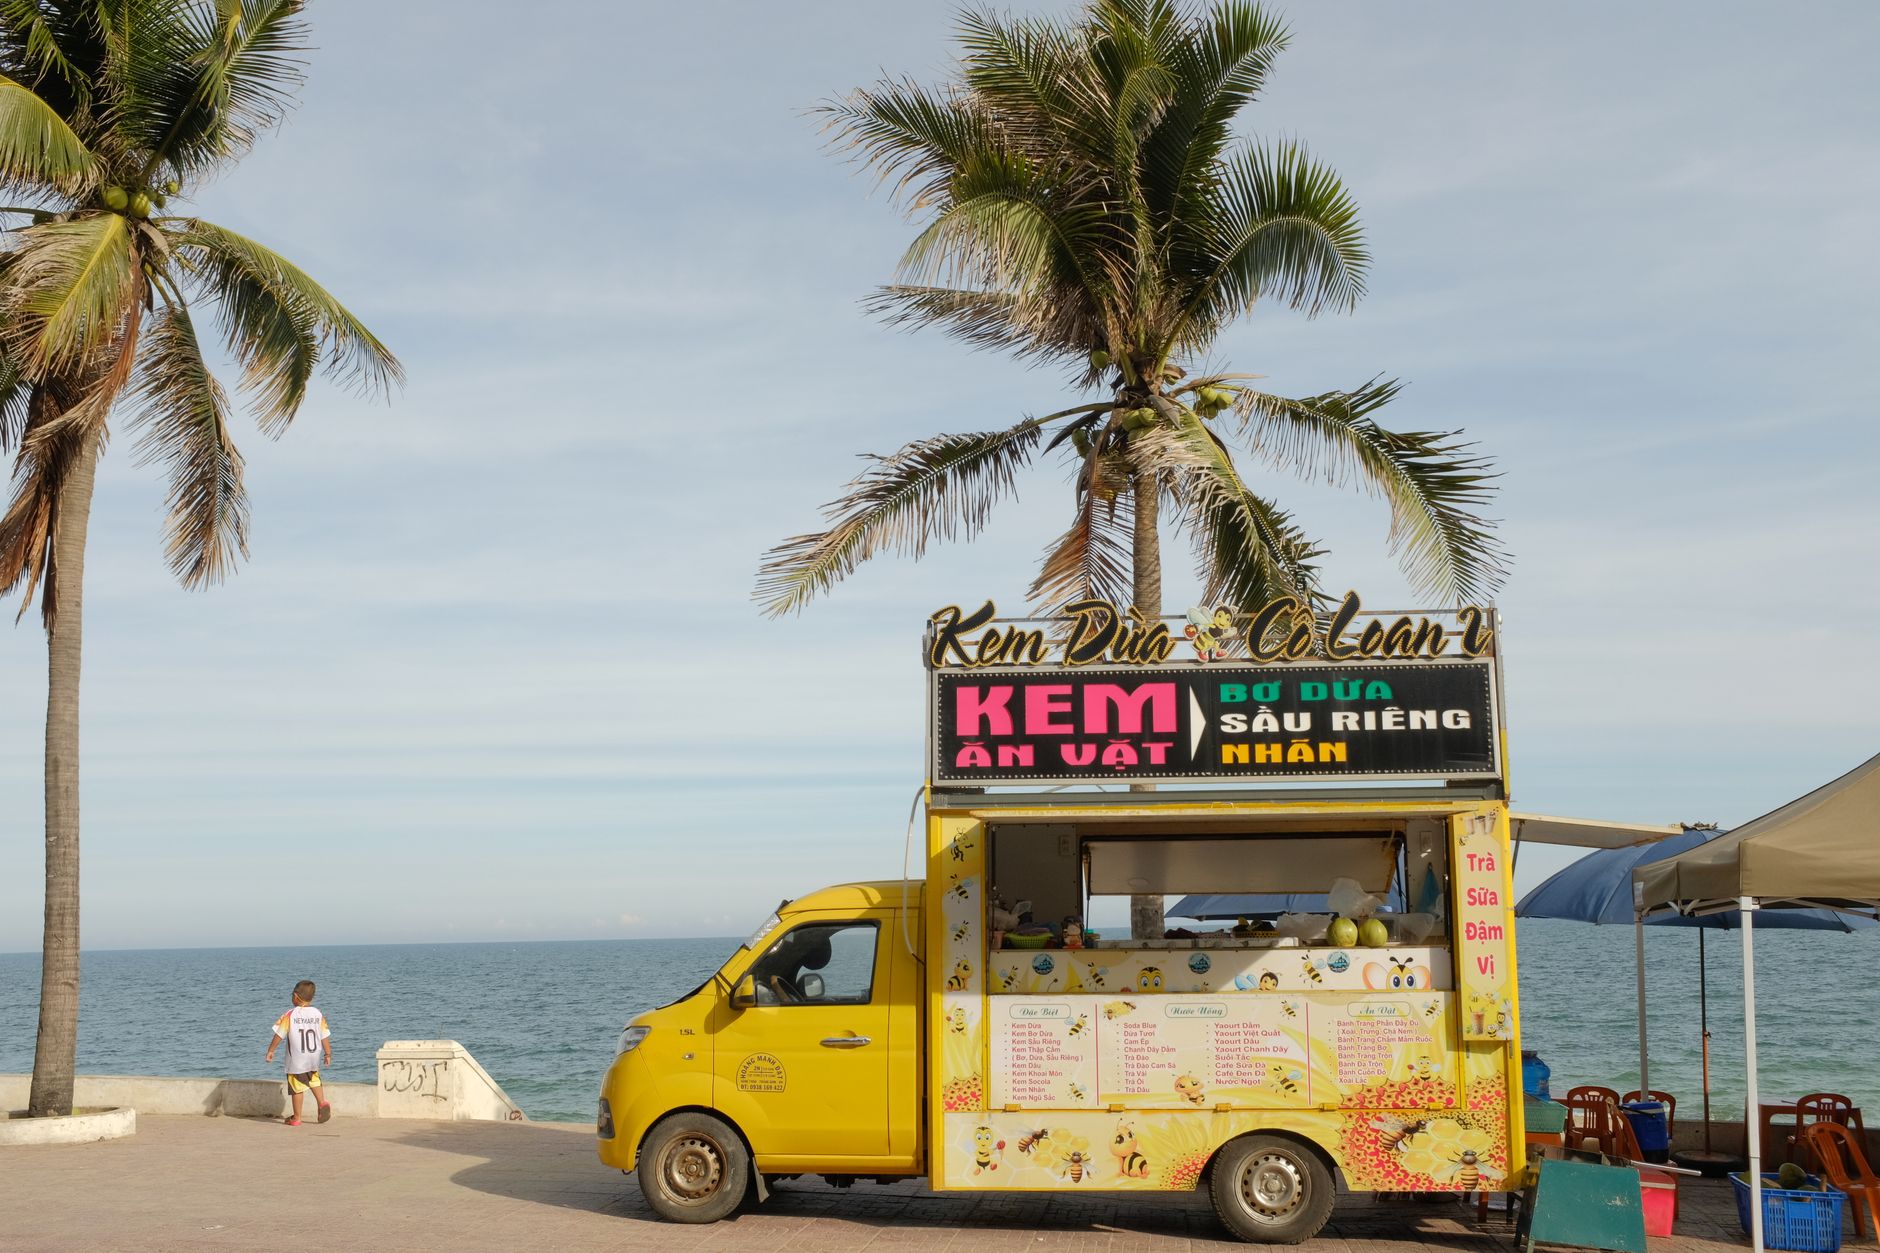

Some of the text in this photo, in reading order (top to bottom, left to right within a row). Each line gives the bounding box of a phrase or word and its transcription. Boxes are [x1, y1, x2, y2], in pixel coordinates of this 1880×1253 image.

[930, 599, 1049, 667] Kem
[1062, 599, 1176, 666] Dừa
[1247, 595, 1316, 662] Cô
[1326, 590, 1449, 660] Loan
[1219, 678, 1393, 703] BƠ DỪA
[956, 682, 1178, 736] KEM
[1220, 706, 1471, 733] SẦU RIÊNG
[956, 739, 1174, 770] ĂN VẶT
[1222, 738, 1347, 764] NHÃN
[1466, 852, 1496, 872] Trà
[1466, 887, 1498, 906] Sữa
[1465, 920, 1503, 944] Đậm
[1477, 955, 1495, 979] Vị
[298, 1029, 317, 1053] 10
